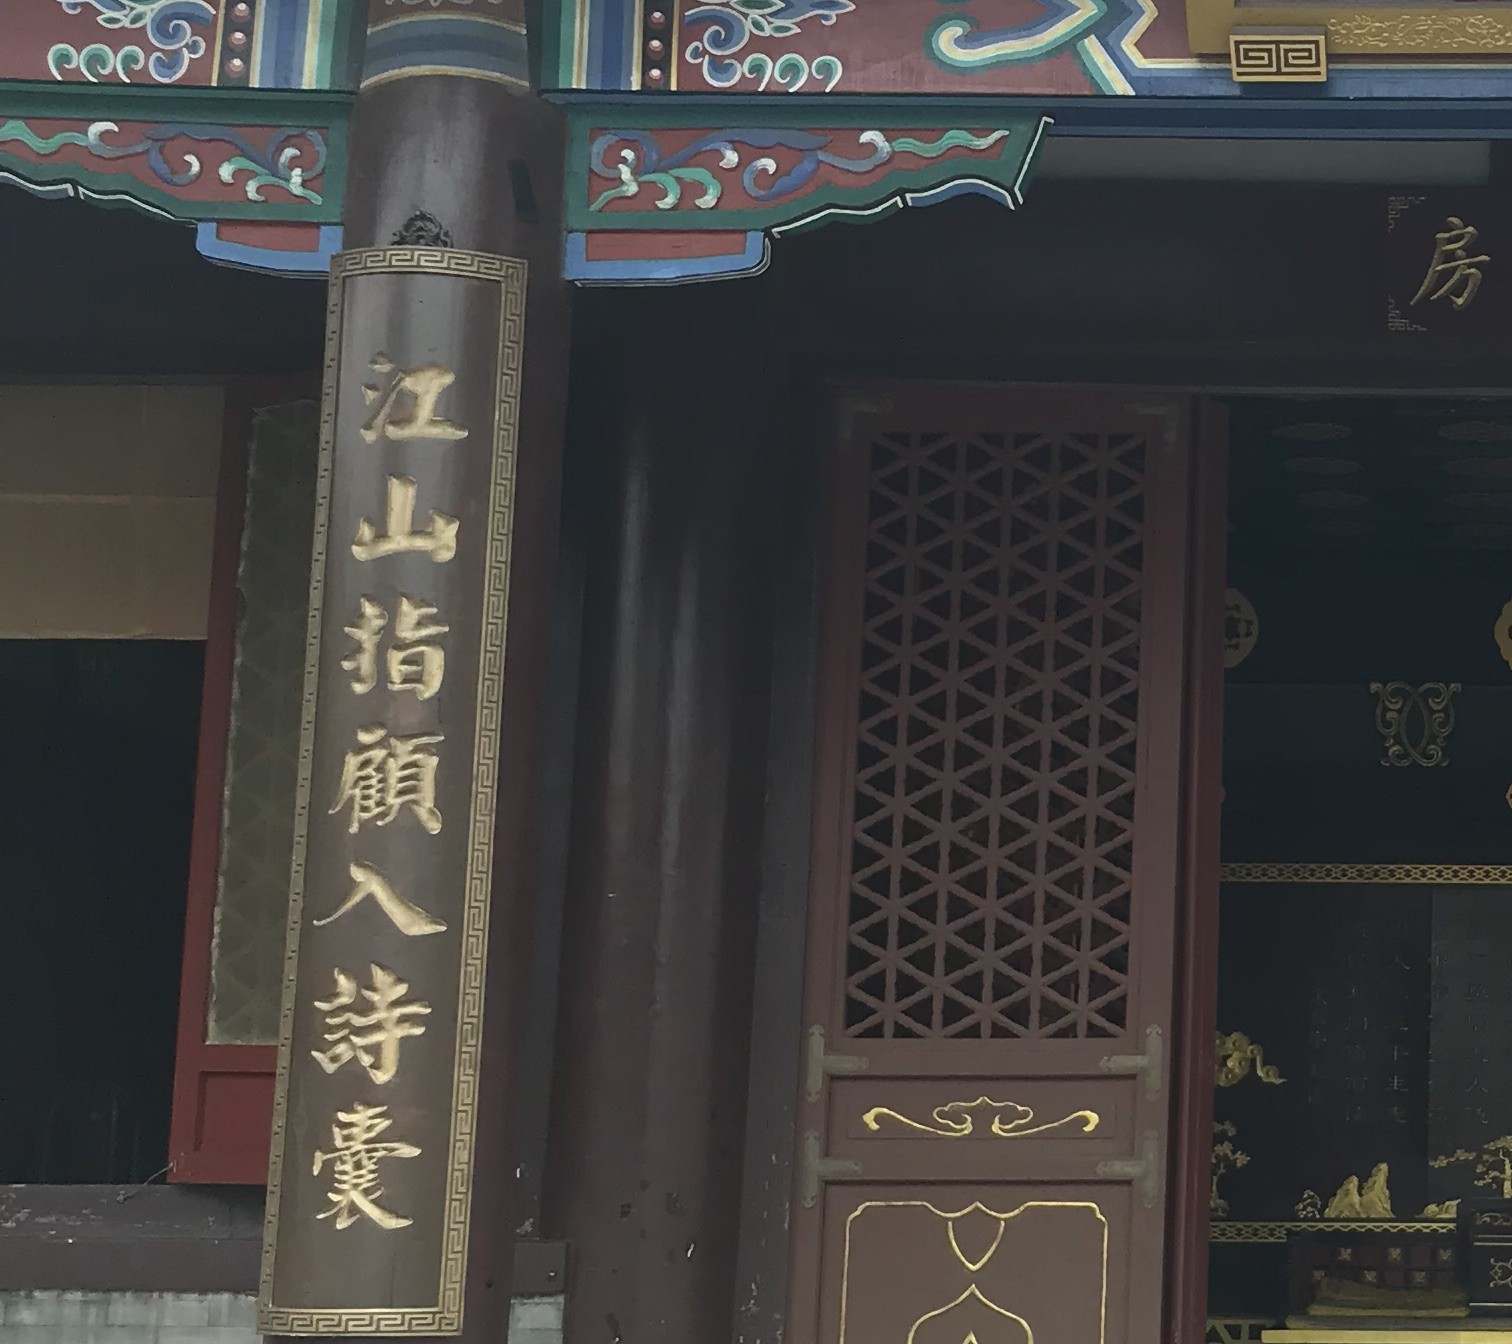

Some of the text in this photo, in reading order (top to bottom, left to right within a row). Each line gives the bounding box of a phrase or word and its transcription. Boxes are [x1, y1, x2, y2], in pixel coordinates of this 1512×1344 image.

[312, 352, 469, 1231] 江山指顧入詩囊
